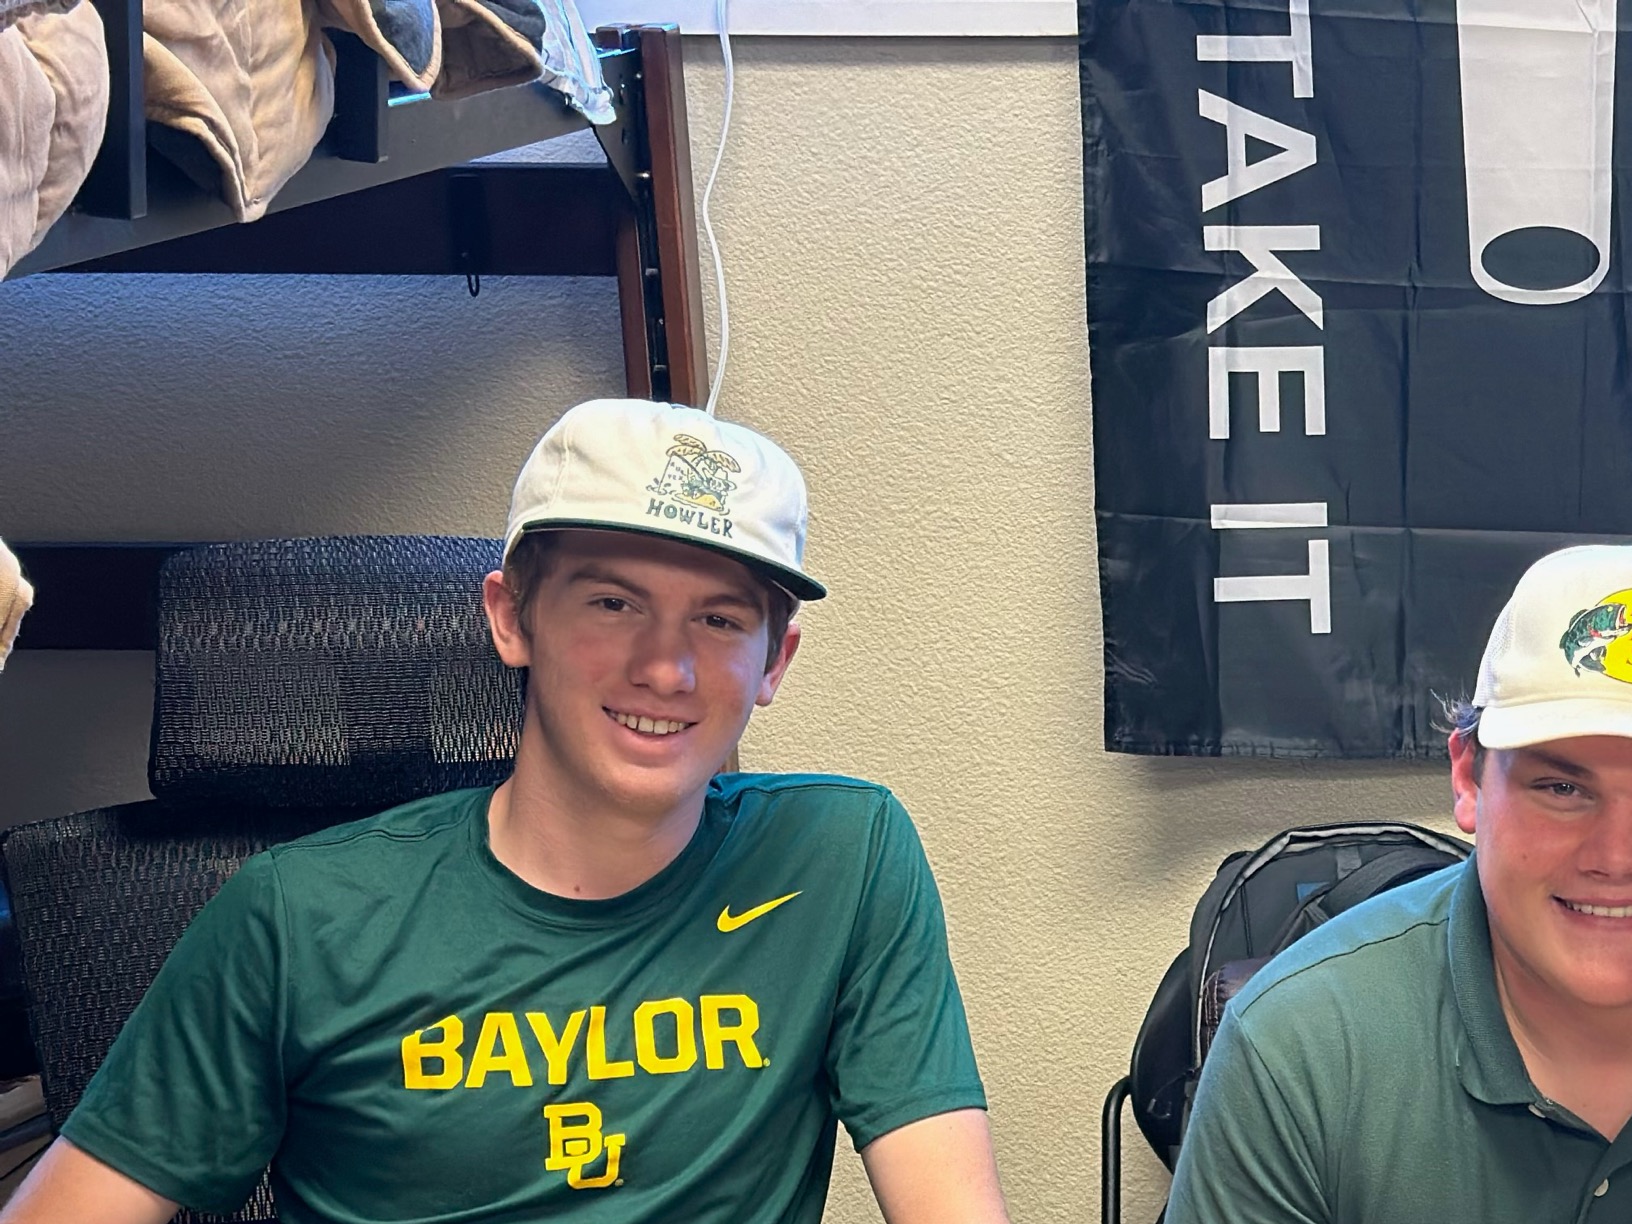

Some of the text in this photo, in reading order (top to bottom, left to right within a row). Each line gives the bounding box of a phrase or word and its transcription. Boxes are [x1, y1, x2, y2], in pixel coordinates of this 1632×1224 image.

[1197, 0, 1331, 634] TAKE IT
[645, 497, 733, 539] HOWLER
[401, 994, 766, 1090] BAYLOR
[544, 1101, 626, 1189] BU
